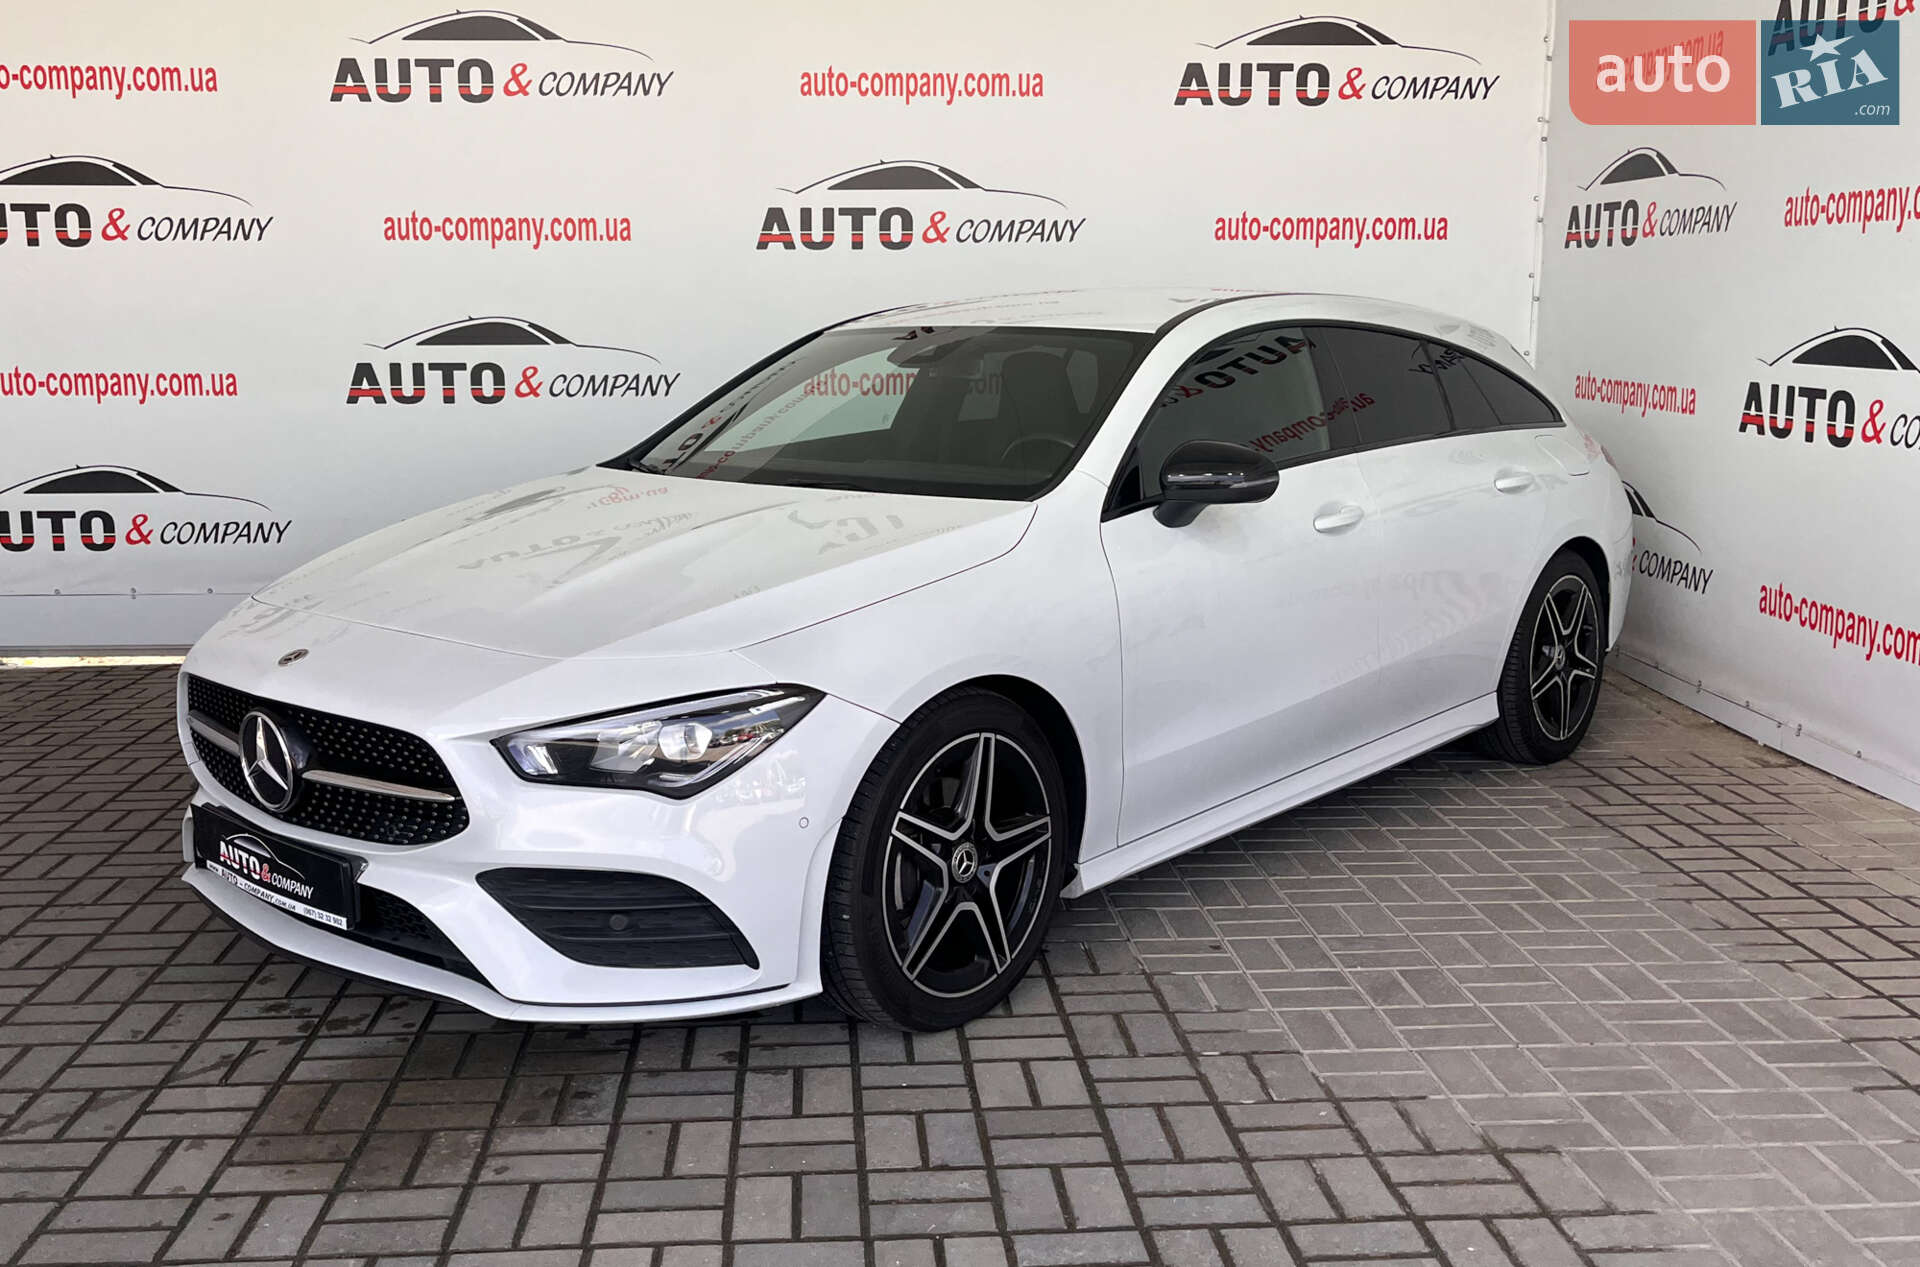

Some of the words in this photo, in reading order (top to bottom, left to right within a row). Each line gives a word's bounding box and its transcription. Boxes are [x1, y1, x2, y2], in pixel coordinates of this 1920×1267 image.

[0, 64, 218, 100] o-company.com.ua
[330, 58, 495, 104] AUTO
[502, 62, 533, 97] &
[538, 70, 675, 97] COMPANY
[800, 66, 1044, 106] auto-company.com.ua
[1174, 62, 1330, 107] AUTO
[1337, 67, 1367, 101] &
[1371, 74, 1501, 101] COMPANY
[0, 203, 92, 247] TO
[101, 207, 131, 242] &
[136, 215, 275, 242] COMPANY
[383, 209, 632, 251] auto-company.com.ua
[756, 206, 914, 251] AUTO
[921, 210, 951, 244] &
[955, 217, 1087, 244] COMPANY
[1215, 211, 1449, 249] auto-company.com.ua
[1564, 199, 1640, 249] AUTO
[1642, 201, 1658, 239] &
[1659, 201, 1738, 237] COMPANY
[0, 365, 238, 404] uto-company.com.ua
[346, 361, 505, 405] AUTO
[514, 365, 544, 399] &
[548, 372, 681, 398] COMPANY
[1575, 371, 1697, 417] auto-company.com.ua
[1738, 381, 1856, 449] AUTO
[1861, 399, 1887, 445] &
[124, 513, 154, 546] &
[159, 519, 293, 546] COMPANY
[1639, 549, 1714, 595] COMPANY
[219, 840, 261, 880] AUTO
[271, 872, 314, 900] COMPANY
